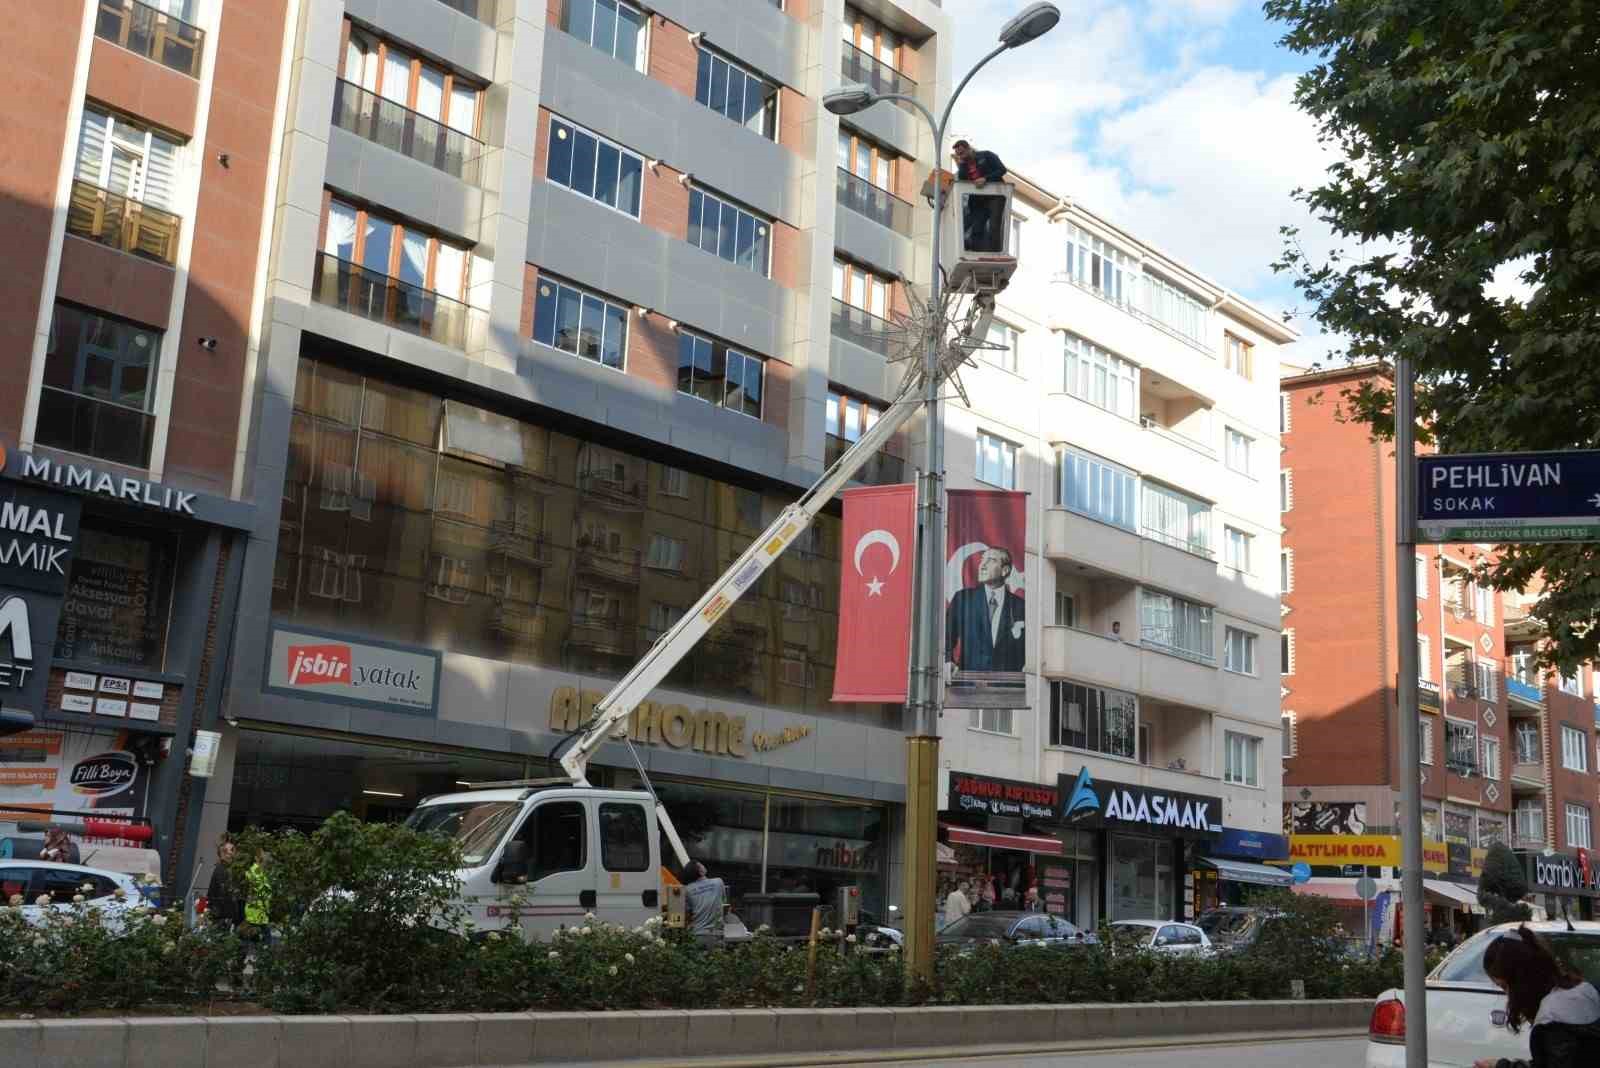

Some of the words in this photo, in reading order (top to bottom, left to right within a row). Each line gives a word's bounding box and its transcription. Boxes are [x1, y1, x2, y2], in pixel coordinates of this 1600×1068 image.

[1431, 463, 1561, 489] PEHLİVAN
[1433, 497, 1496, 511] SOKAK
[353, 664, 421, 690] yatak
[75, 765, 98, 781] Filli
[99, 763, 132, 784] Boya
[1105, 788, 1209, 831] ADASMAK
[1536, 856, 1575, 889] bambi
